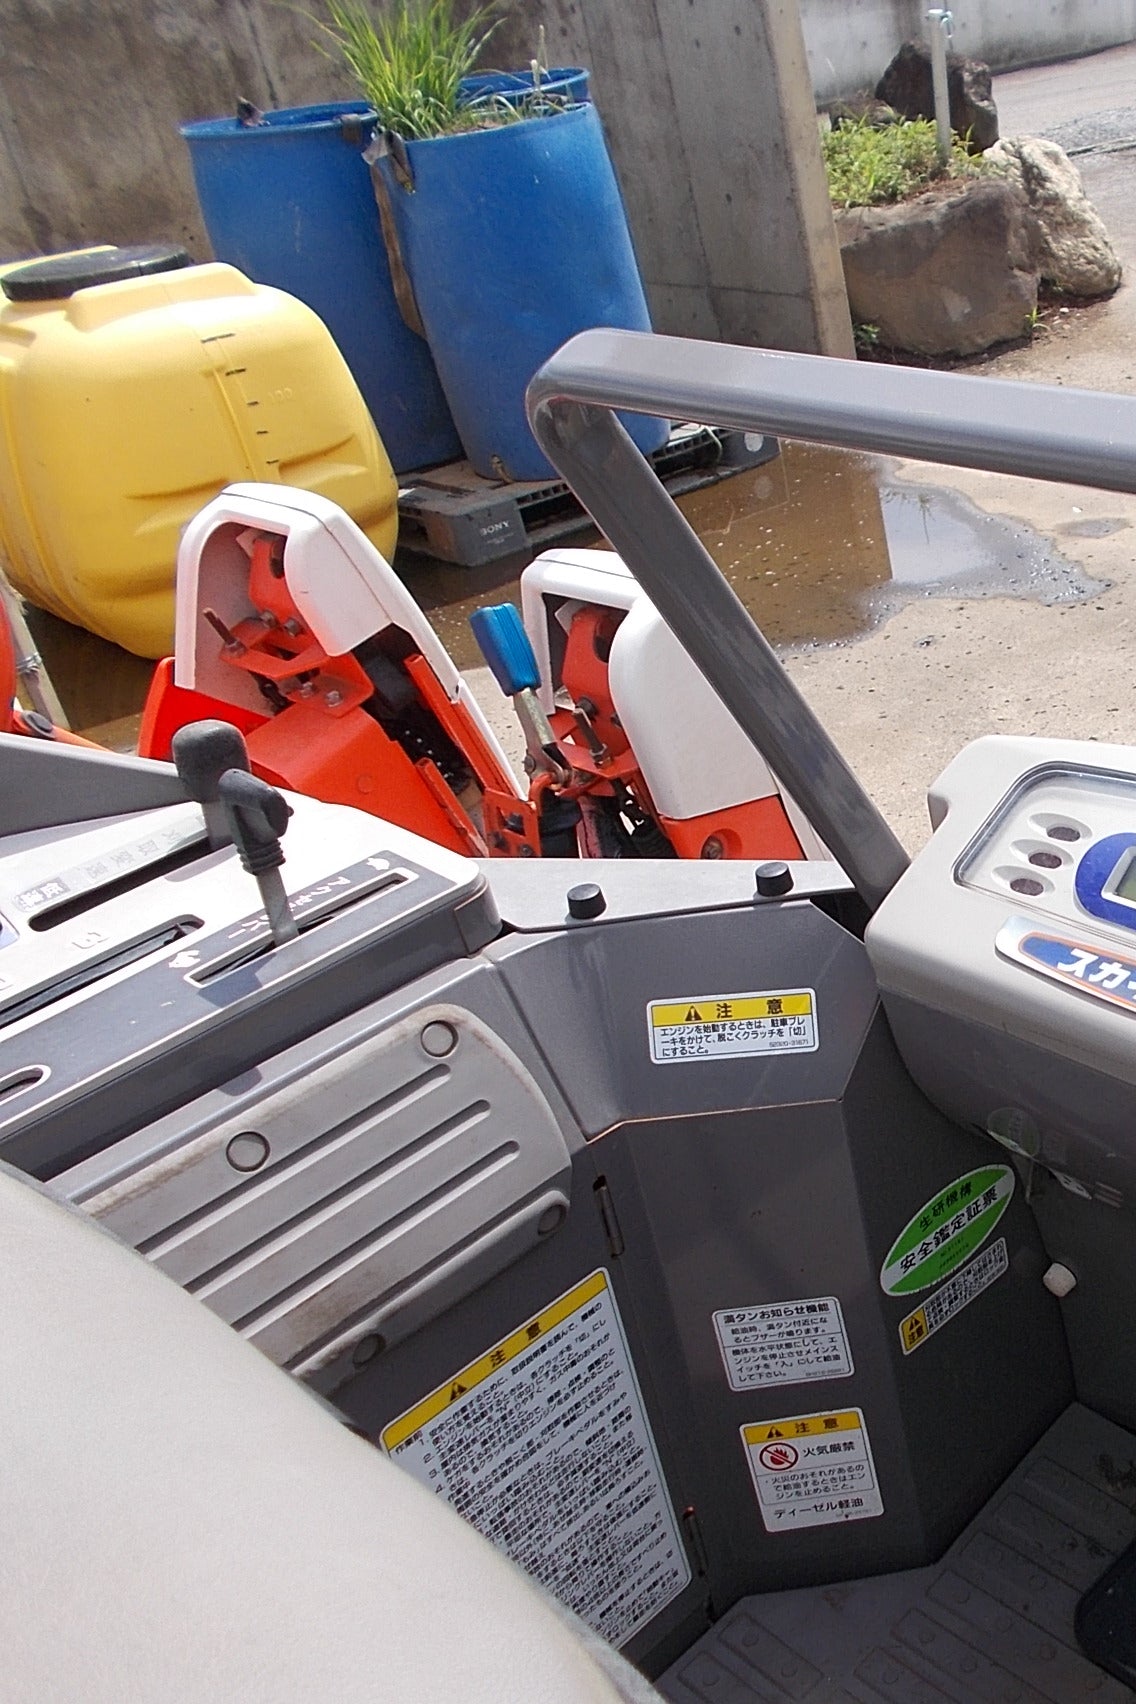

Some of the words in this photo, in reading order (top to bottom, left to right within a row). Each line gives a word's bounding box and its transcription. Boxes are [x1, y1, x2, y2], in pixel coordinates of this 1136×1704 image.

[716, 999, 784, 1019] 注意
[662, 1045, 710, 1057] にすること。
[919, 1181, 973, 1233] 生研機構
[723, 1302, 830, 1324] 満タンお知らせ機能
[490, 1321, 542, 1368] 注意
[795, 1418, 839, 1434] 注意
[803, 1441, 856, 1458] 火気厳禁
[774, 1497, 864, 1519] ディーゼル軽油
